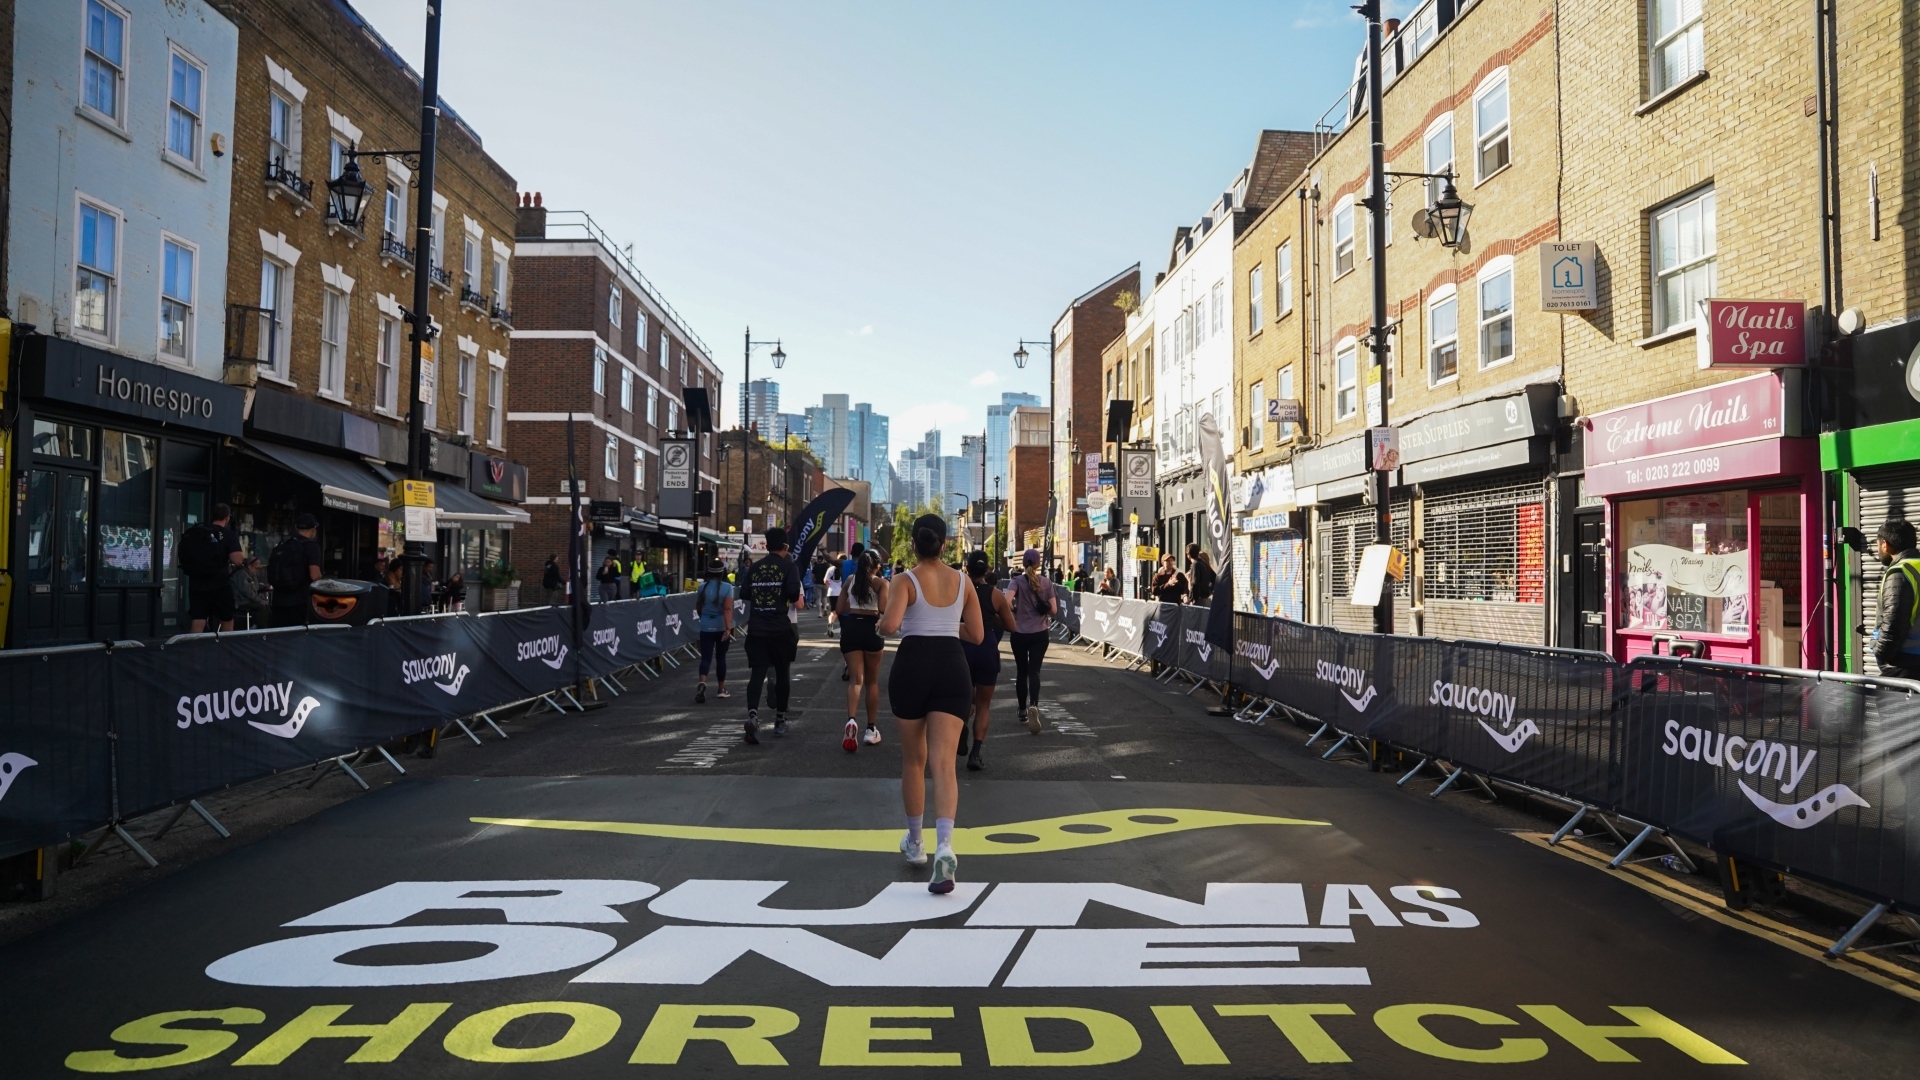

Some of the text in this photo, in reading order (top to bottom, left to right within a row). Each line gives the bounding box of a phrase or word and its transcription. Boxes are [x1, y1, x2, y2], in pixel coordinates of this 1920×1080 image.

[1553, 243, 1581, 252] TO LET
[1718, 303, 1797, 331] Nails
[1731, 330, 1787, 360] Spa
[97, 364, 213, 419] Homespro
[1269, 399, 1279, 416] 2
[1424, 418, 1471, 444] SUPPLIES
[1605, 394, 1777, 456] Extreme Nails 161
[1625, 456, 1720, 485] Tel: 0203 222 0099
[324, 496, 360, 512] The Hoxton Barrel
[1241, 513, 1287, 532] DRY CLEANERS
[791, 518, 815, 562] aucony
[1680, 556, 1704, 567] Waxing
[1667, 597, 1703, 614] NAILS
[637, 619, 654, 638] saucony
[1675, 613, 1703, 629] SPA
[517, 634, 561, 663] saucony
[592, 627, 617, 650] saucony
[1185, 628, 1206, 650] saucony
[1235, 638, 1272, 667] saucony
[402, 651, 458, 687] saucony
[1316, 658, 1365, 695] saucony
[177, 680, 294, 730] saucony
[1429, 679, 1517, 729] saucony
[1661, 719, 1817, 794] saucony
[281, 879, 1480, 928] RUN AS
[205, 924, 1372, 987] ONE
[64, 1002, 1750, 1073] SHOREDITCH
